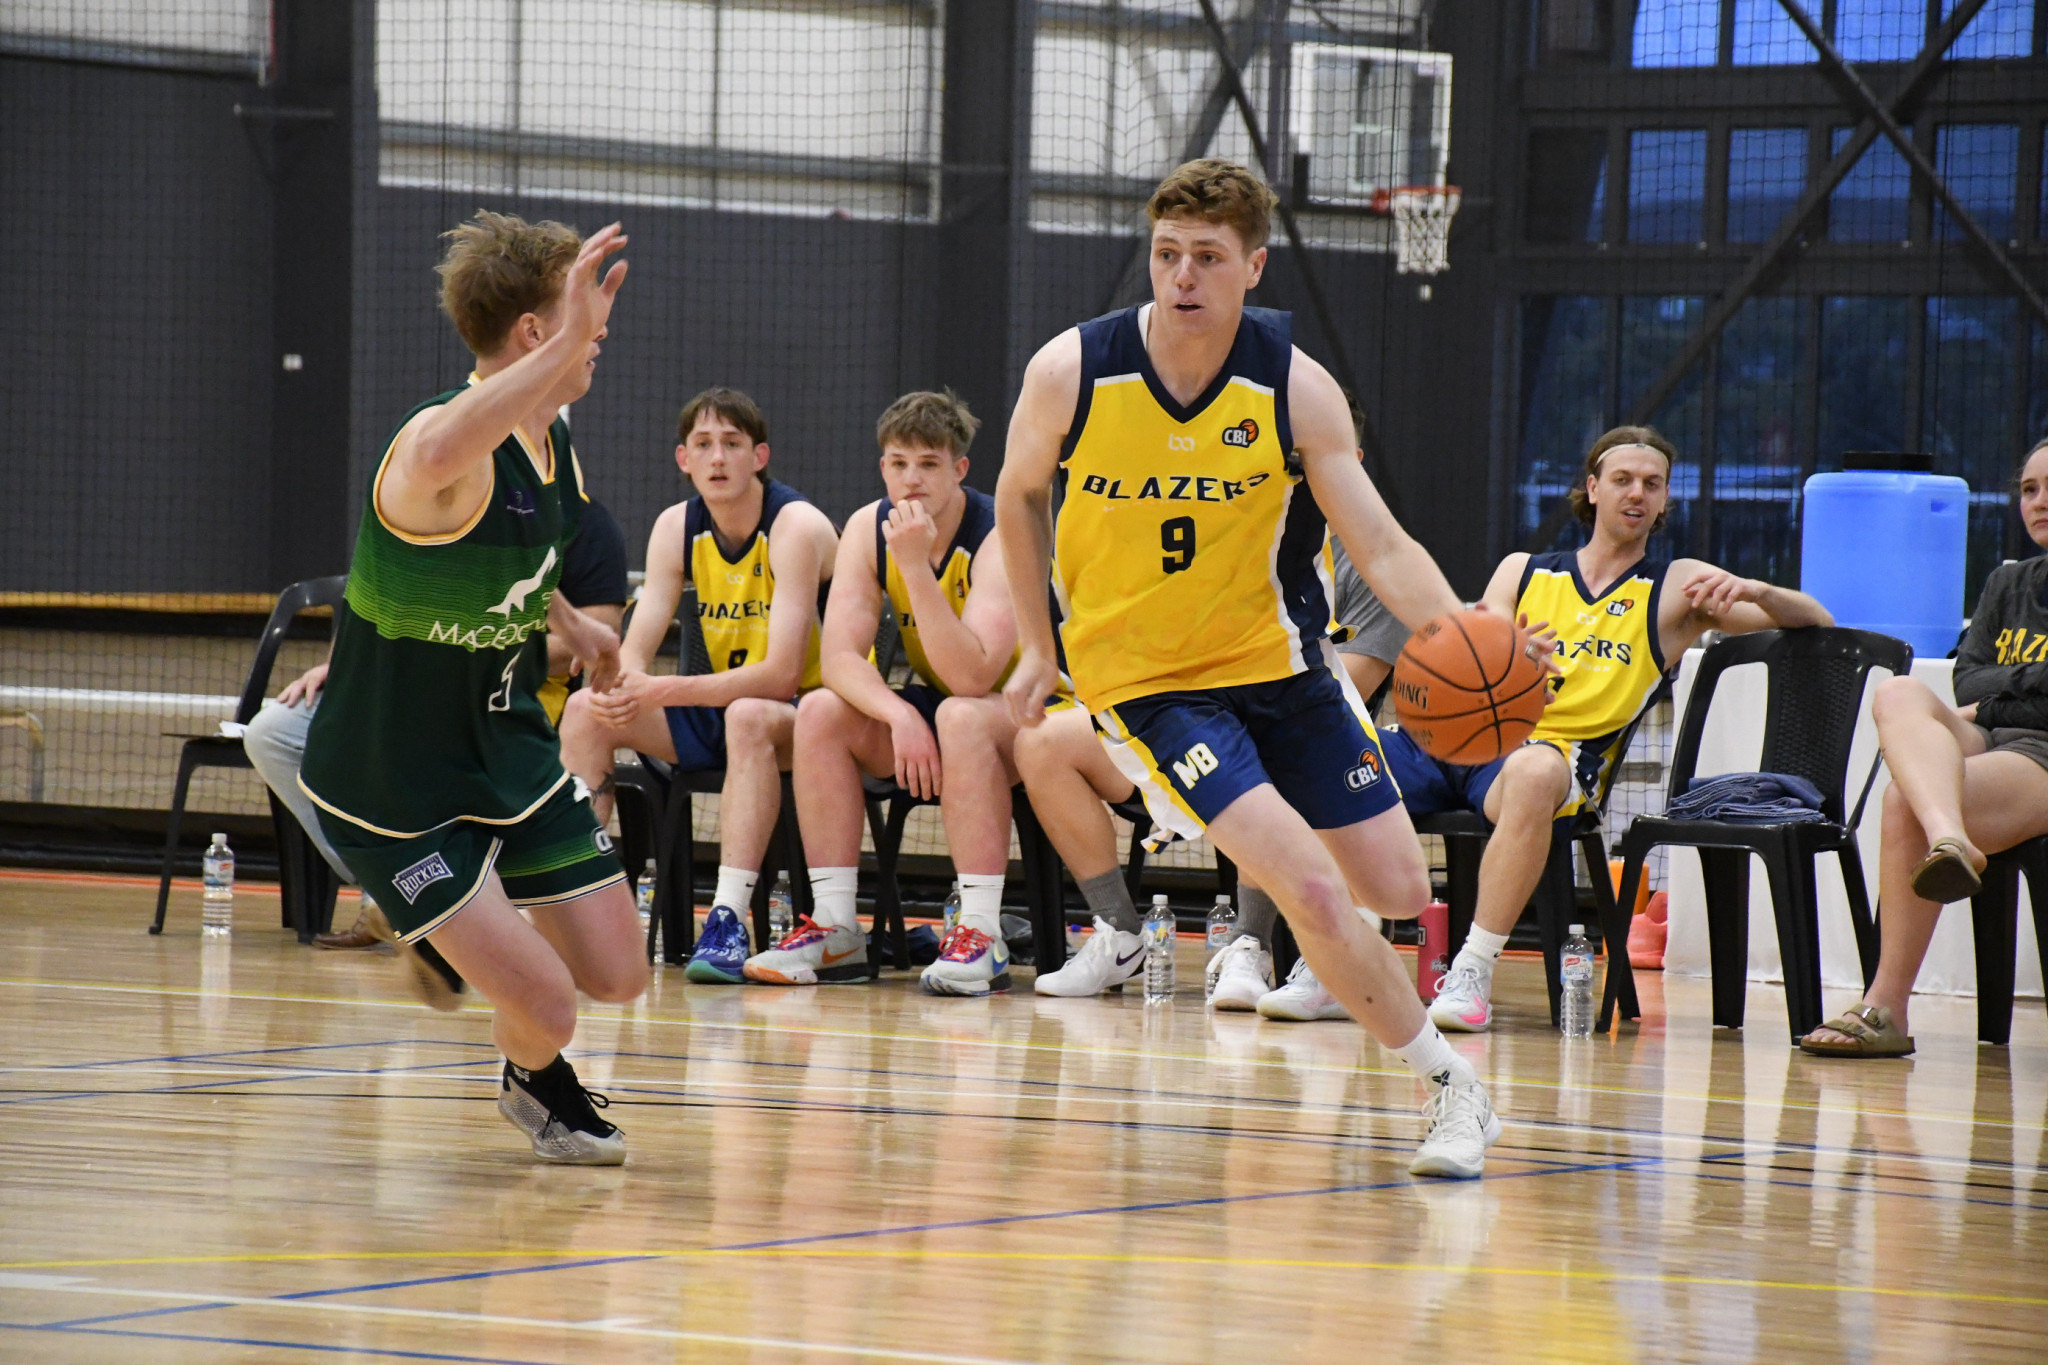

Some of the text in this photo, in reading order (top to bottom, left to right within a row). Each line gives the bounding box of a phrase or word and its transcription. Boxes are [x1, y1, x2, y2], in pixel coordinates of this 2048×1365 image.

[1224, 429, 1249, 446] CBL
[1160, 516, 1196, 575] 9
[1172, 742, 1220, 791] MB
[1347, 764, 1378, 789] CBL
